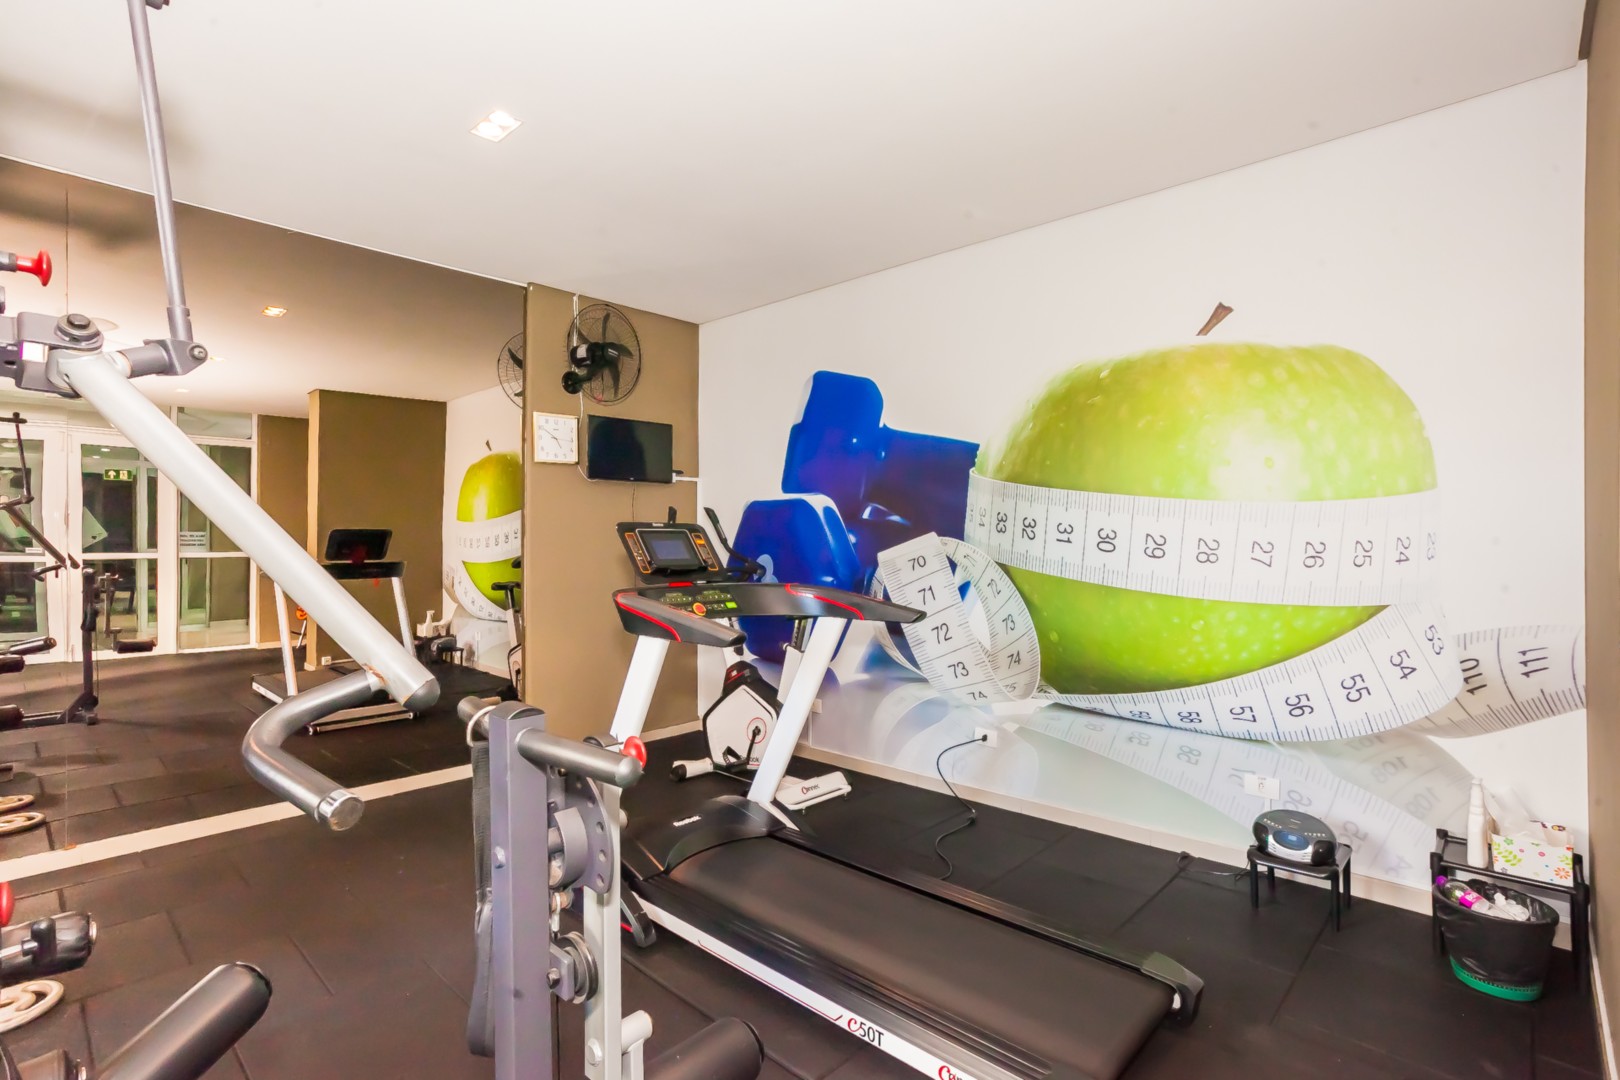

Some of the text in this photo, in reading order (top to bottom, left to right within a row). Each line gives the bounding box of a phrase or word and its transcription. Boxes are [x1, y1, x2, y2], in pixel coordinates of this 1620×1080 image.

[995, 511, 1008, 535] 33
[1021, 516, 1037, 541] 32
[1056, 522, 1074, 545] 31
[1096, 528, 1117, 553] 30
[1144, 533, 1167, 560] 29
[1196, 538, 1221, 565] 28
[1250, 540, 1275, 569] 27
[1302, 540, 1327, 569] 26
[1353, 539, 1374, 568] 25
[1394, 536, 1411, 566] 24
[907, 555, 927, 571] 70
[917, 585, 937, 606] 71
[987, 578, 1001, 599] 72
[1002, 613, 1016, 632] 73
[931, 622, 953, 645] 72
[948, 661, 970, 679] 73
[1007, 650, 1021, 669] 74
[1177, 711, 1202, 724] 58
[1229, 705, 1257, 724] 57
[1284, 692, 1314, 718] 56
[1340, 673, 1372, 703] 55
[1389, 648, 1418, 680] 54
[1424, 624, 1445, 656] 53
[1459, 646, 1550, 696] 110 111
[847, 1017, 884, 1047] C50T
